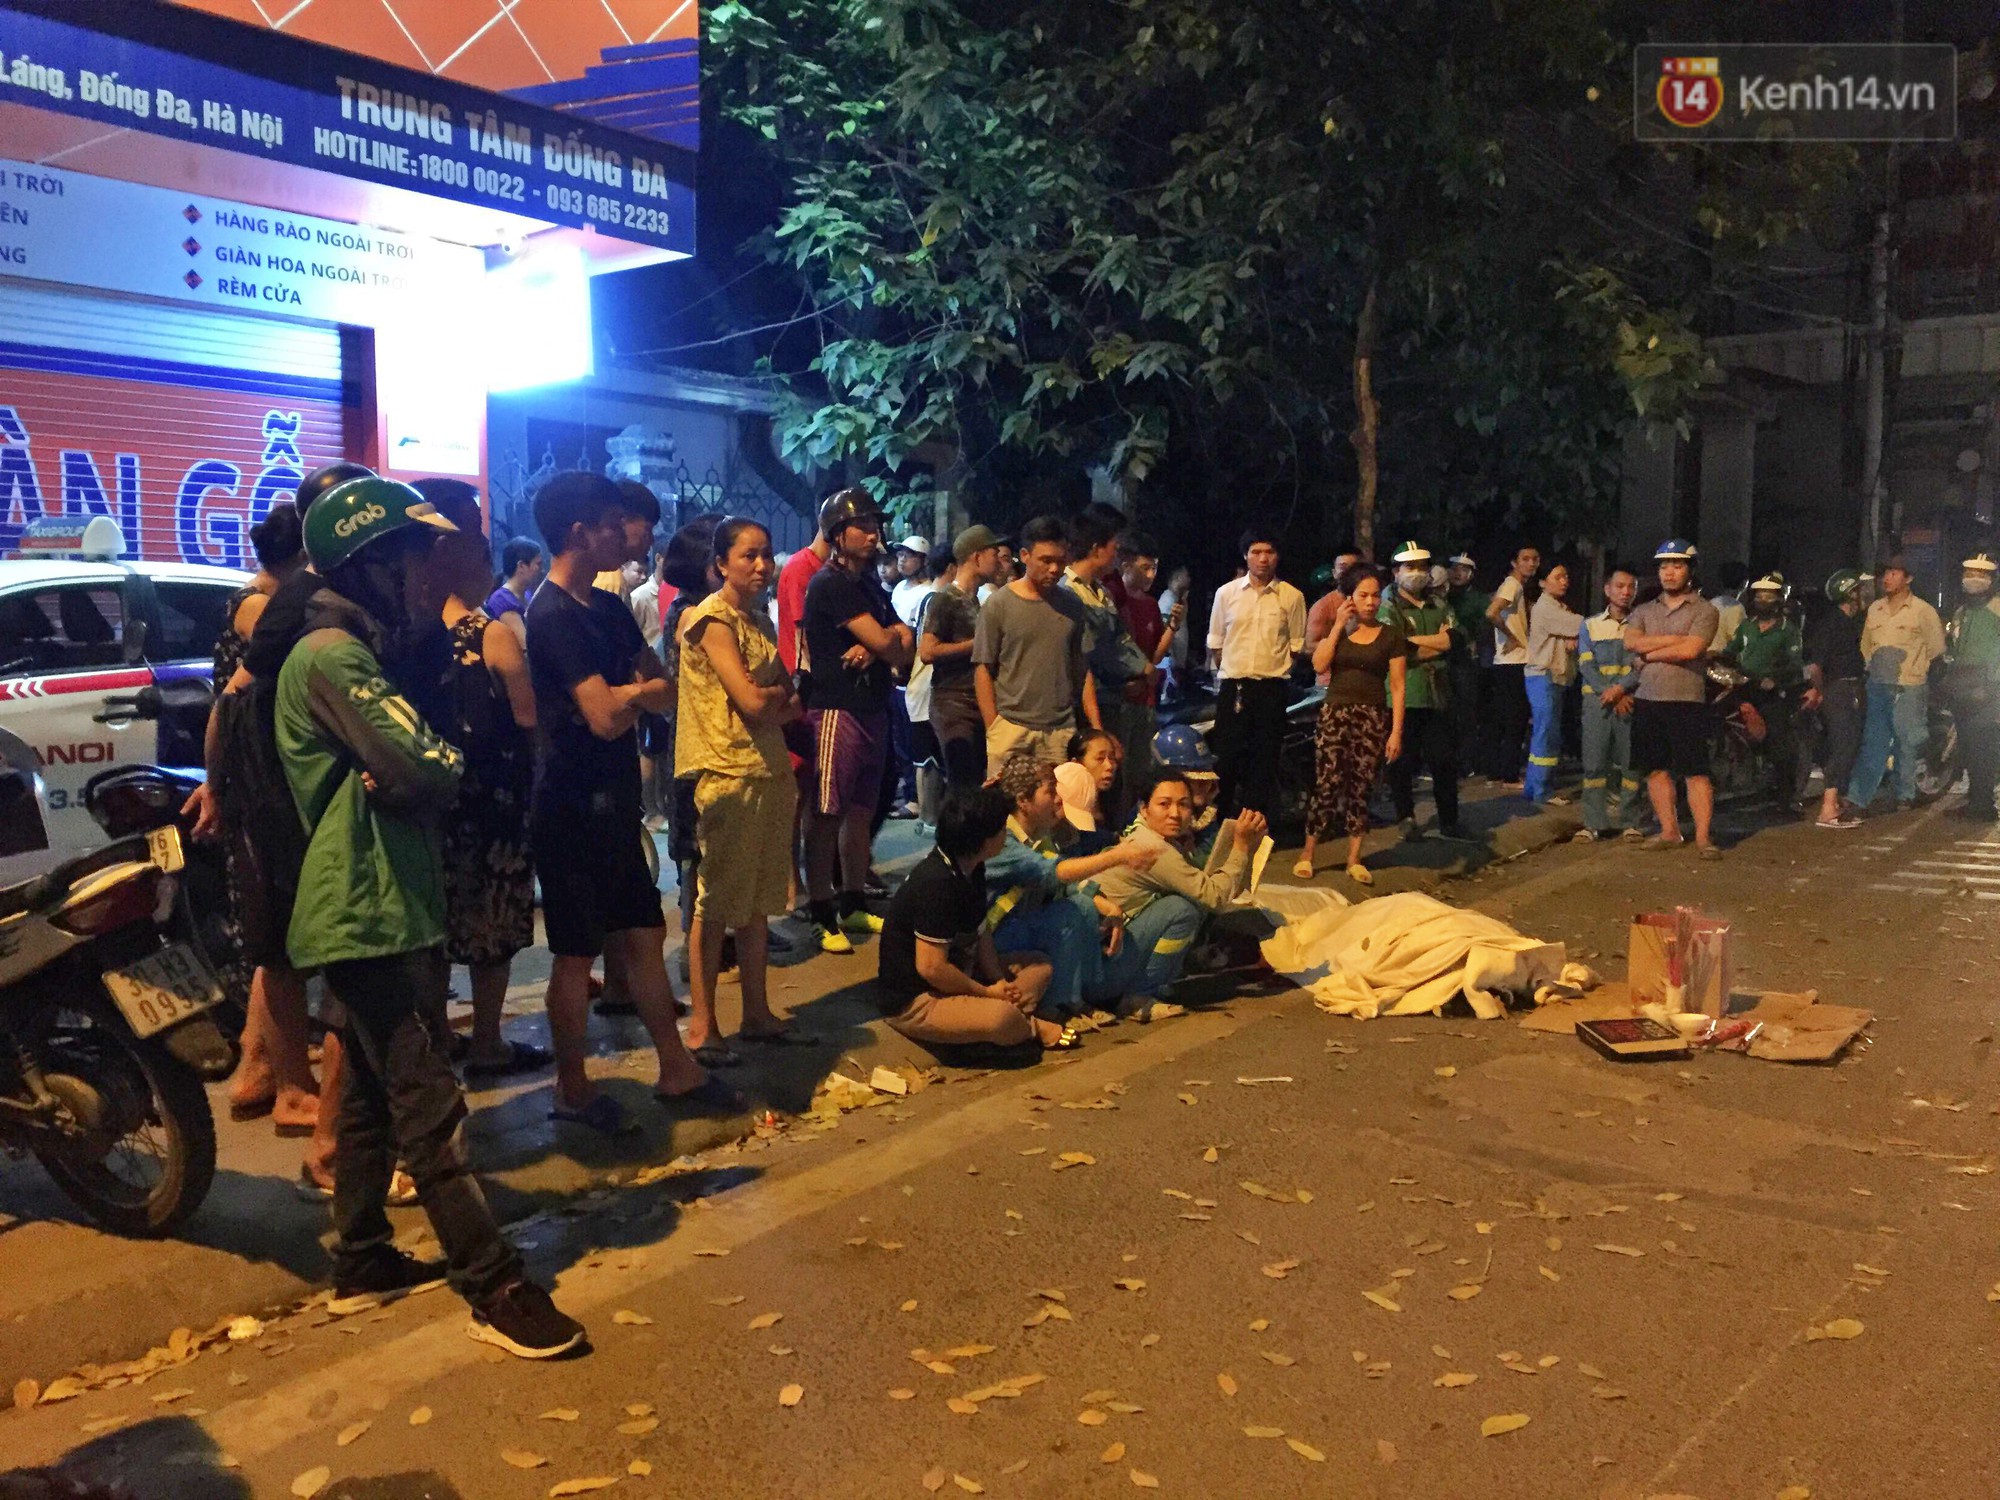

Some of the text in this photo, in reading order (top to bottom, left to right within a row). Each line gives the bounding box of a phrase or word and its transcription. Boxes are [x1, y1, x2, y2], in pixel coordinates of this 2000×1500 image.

[79, 69, 149, 118] Đống
[156, 88, 198, 129] Đa,
[203, 99, 236, 135] Hà
[241, 109, 283, 149] Nội
[336, 75, 669, 200] TRUNG TÂM ĐỐNG ĐA
[13, 172, 64, 197] TRỜI
[473, 166, 525, 201] 0022
[547, 185, 583, 212] 093
[586, 198, 621, 221] 685
[624, 204, 669, 235] 2233
[215, 209, 269, 234] HÀNG
[275, 221, 311, 242] RÀO
[316, 230, 371, 252] NGOÀI
[216, 245, 261, 267] GIÀN
[267, 255, 306, 275] HOA
[312, 262, 366, 285] NGOÀI
[218, 276, 302, 305] RÈM CỬA
[334, 502, 386, 537] Grab
